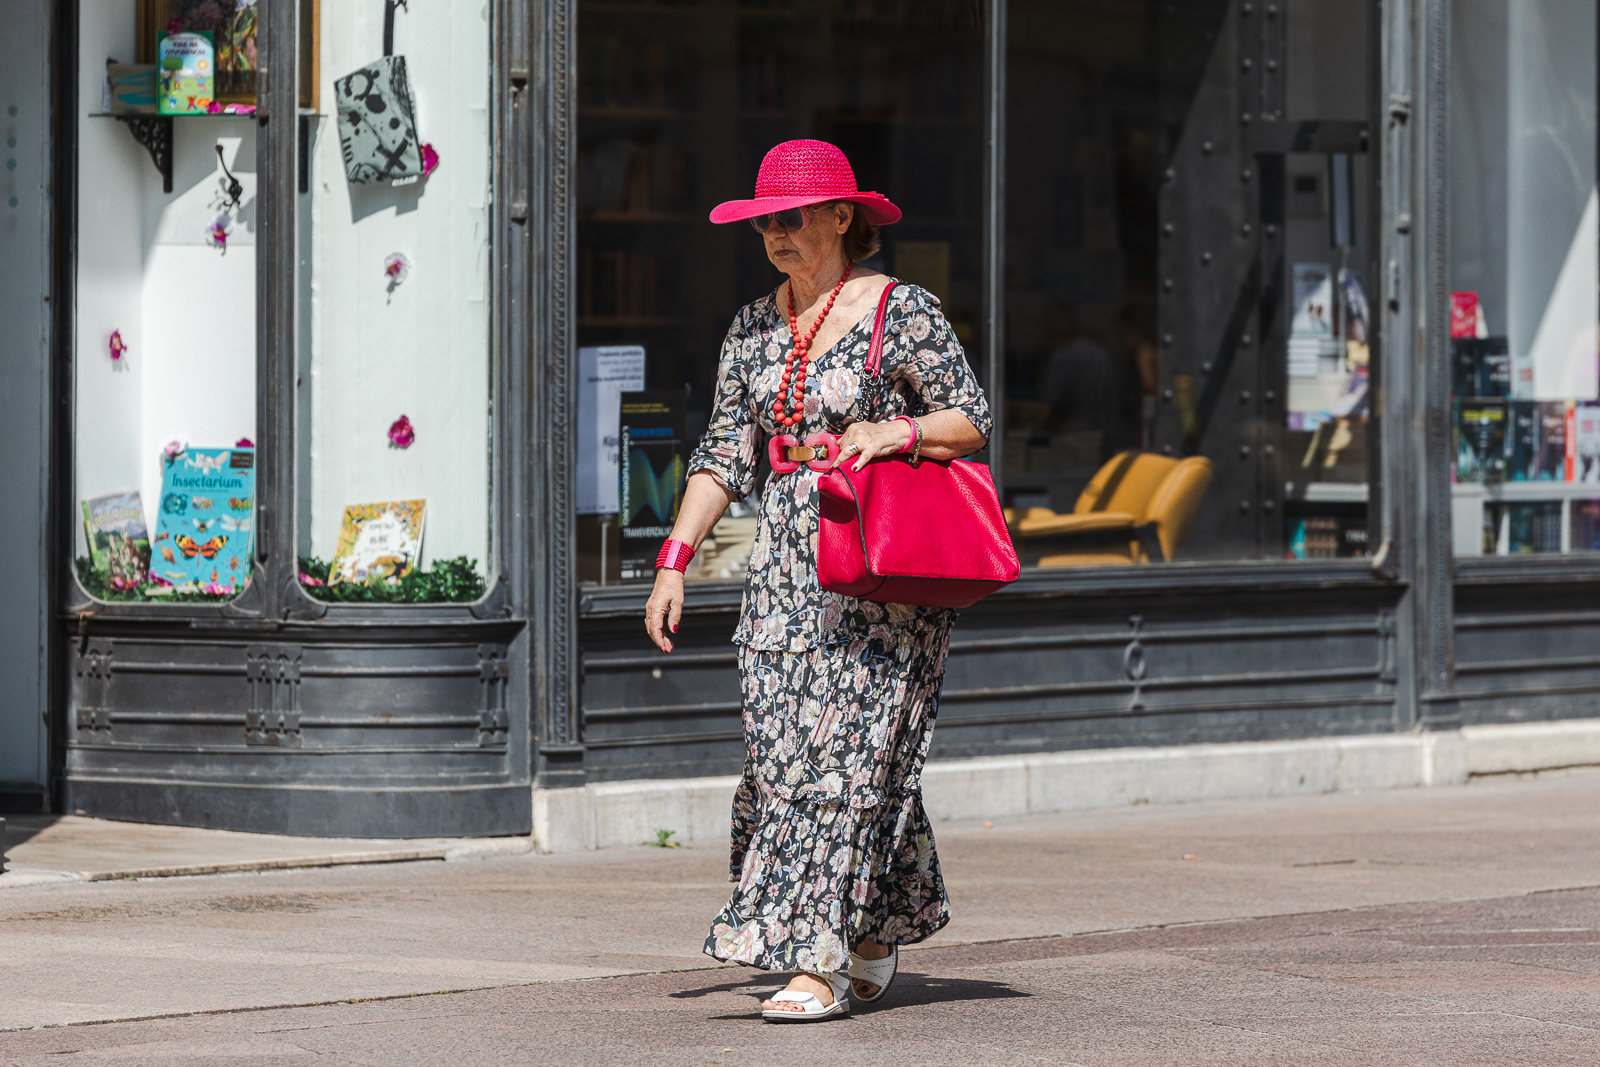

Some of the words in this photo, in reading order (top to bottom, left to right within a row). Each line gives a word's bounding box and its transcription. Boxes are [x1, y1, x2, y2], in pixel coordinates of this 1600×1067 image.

[172, 473, 243, 488] Insectarium
[622, 425, 630, 526] LONGITUDINALNO
[369, 535, 388, 544] BUBE
